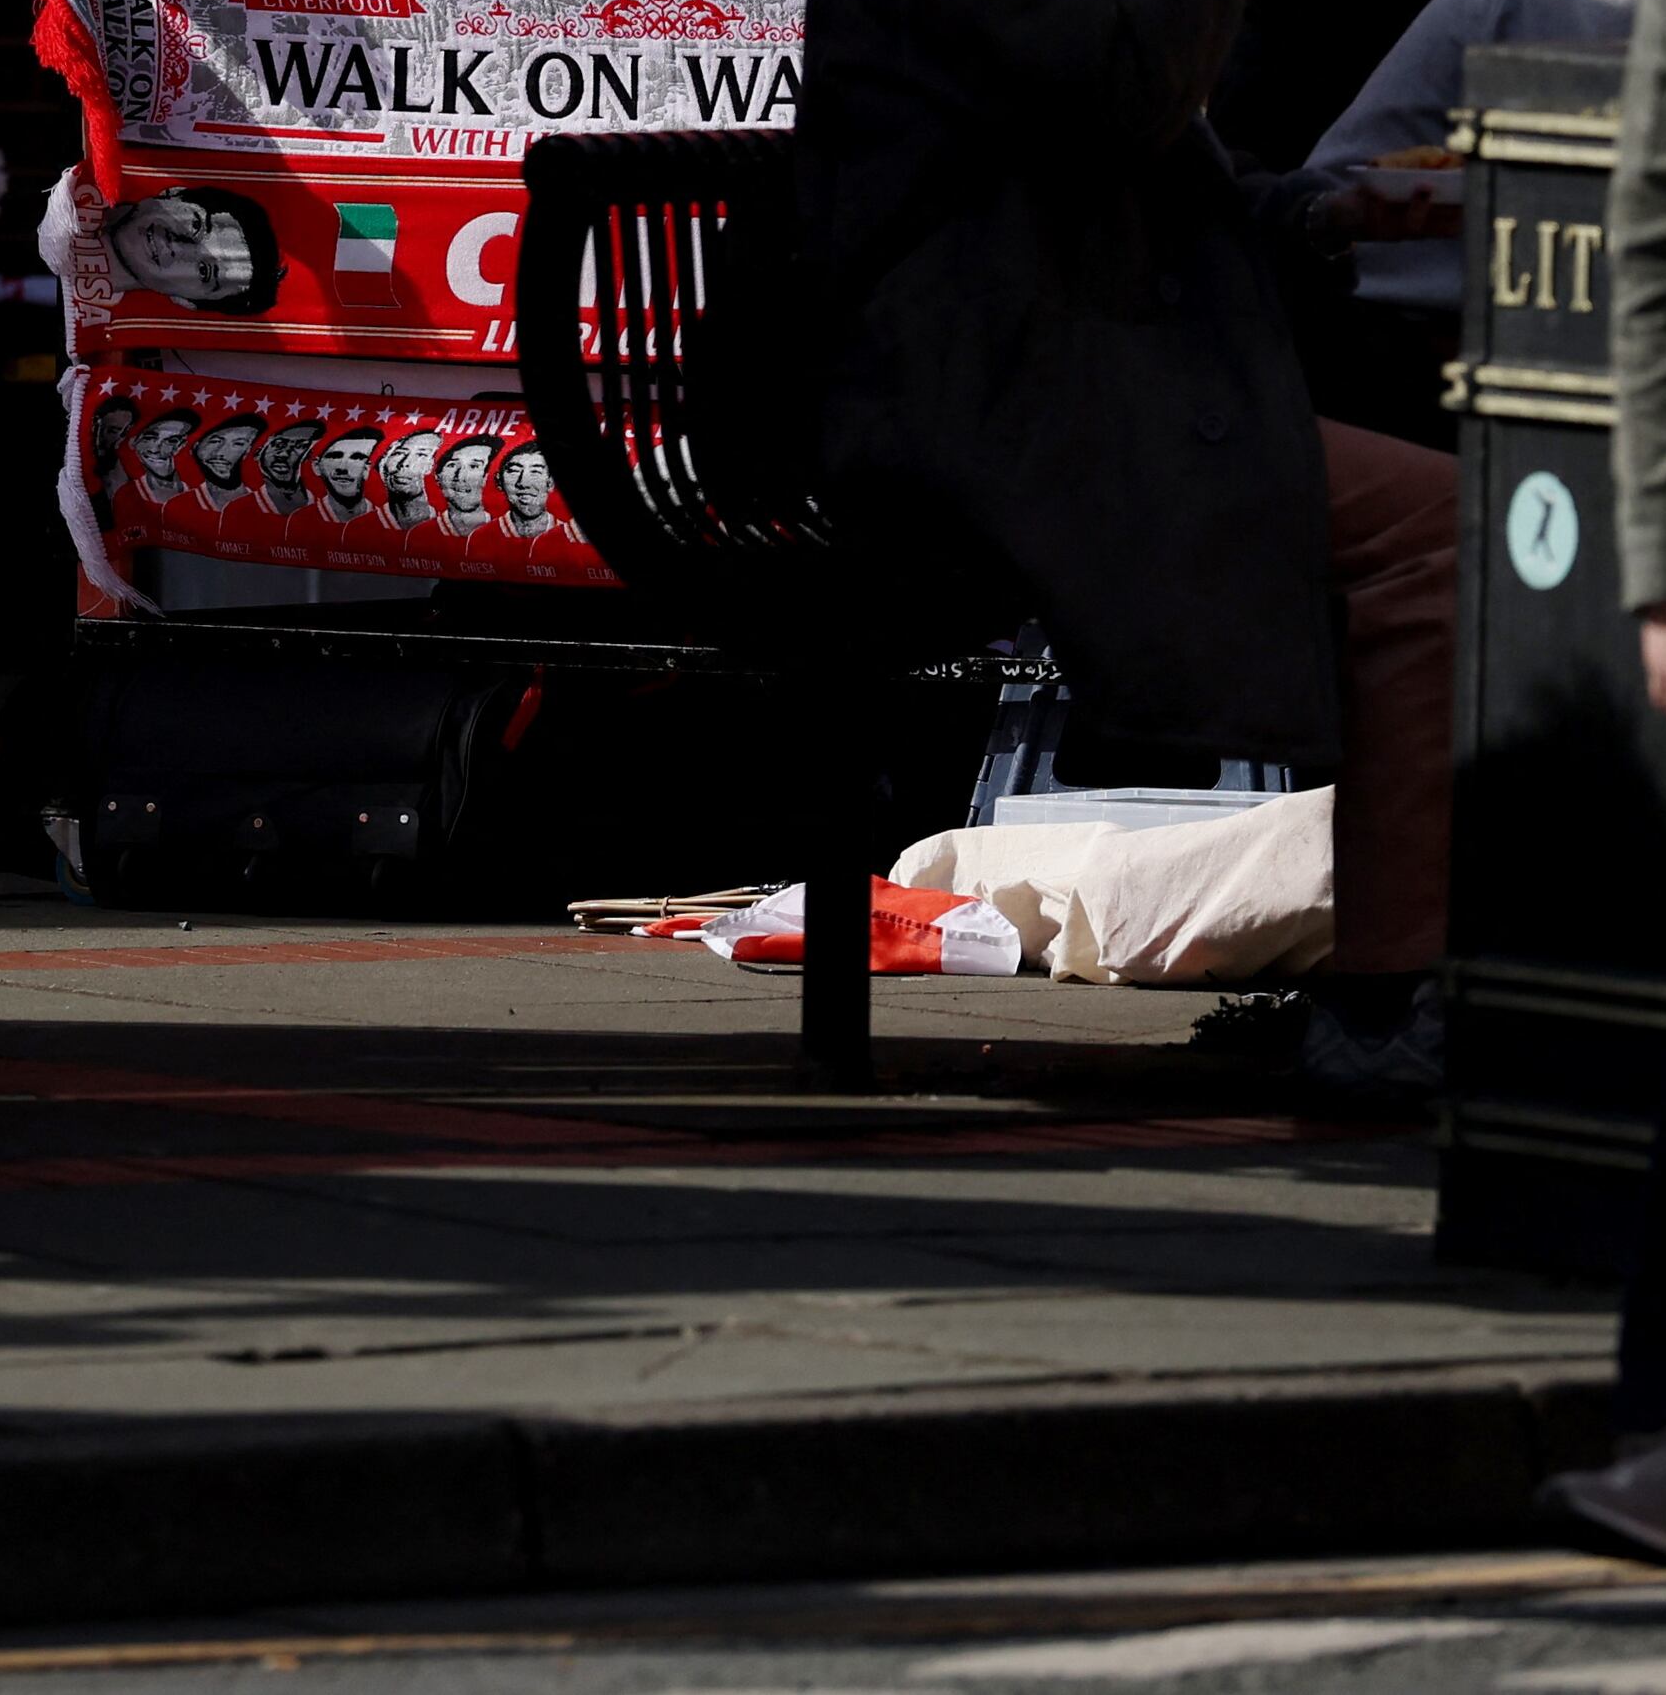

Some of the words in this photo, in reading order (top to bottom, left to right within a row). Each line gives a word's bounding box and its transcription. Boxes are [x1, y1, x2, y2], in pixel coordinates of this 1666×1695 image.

[252, 38, 493, 116] WALK
[525, 52, 642, 120] ON
[412, 128, 510, 156] WITH
[434, 409, 524, 436] ARNE
